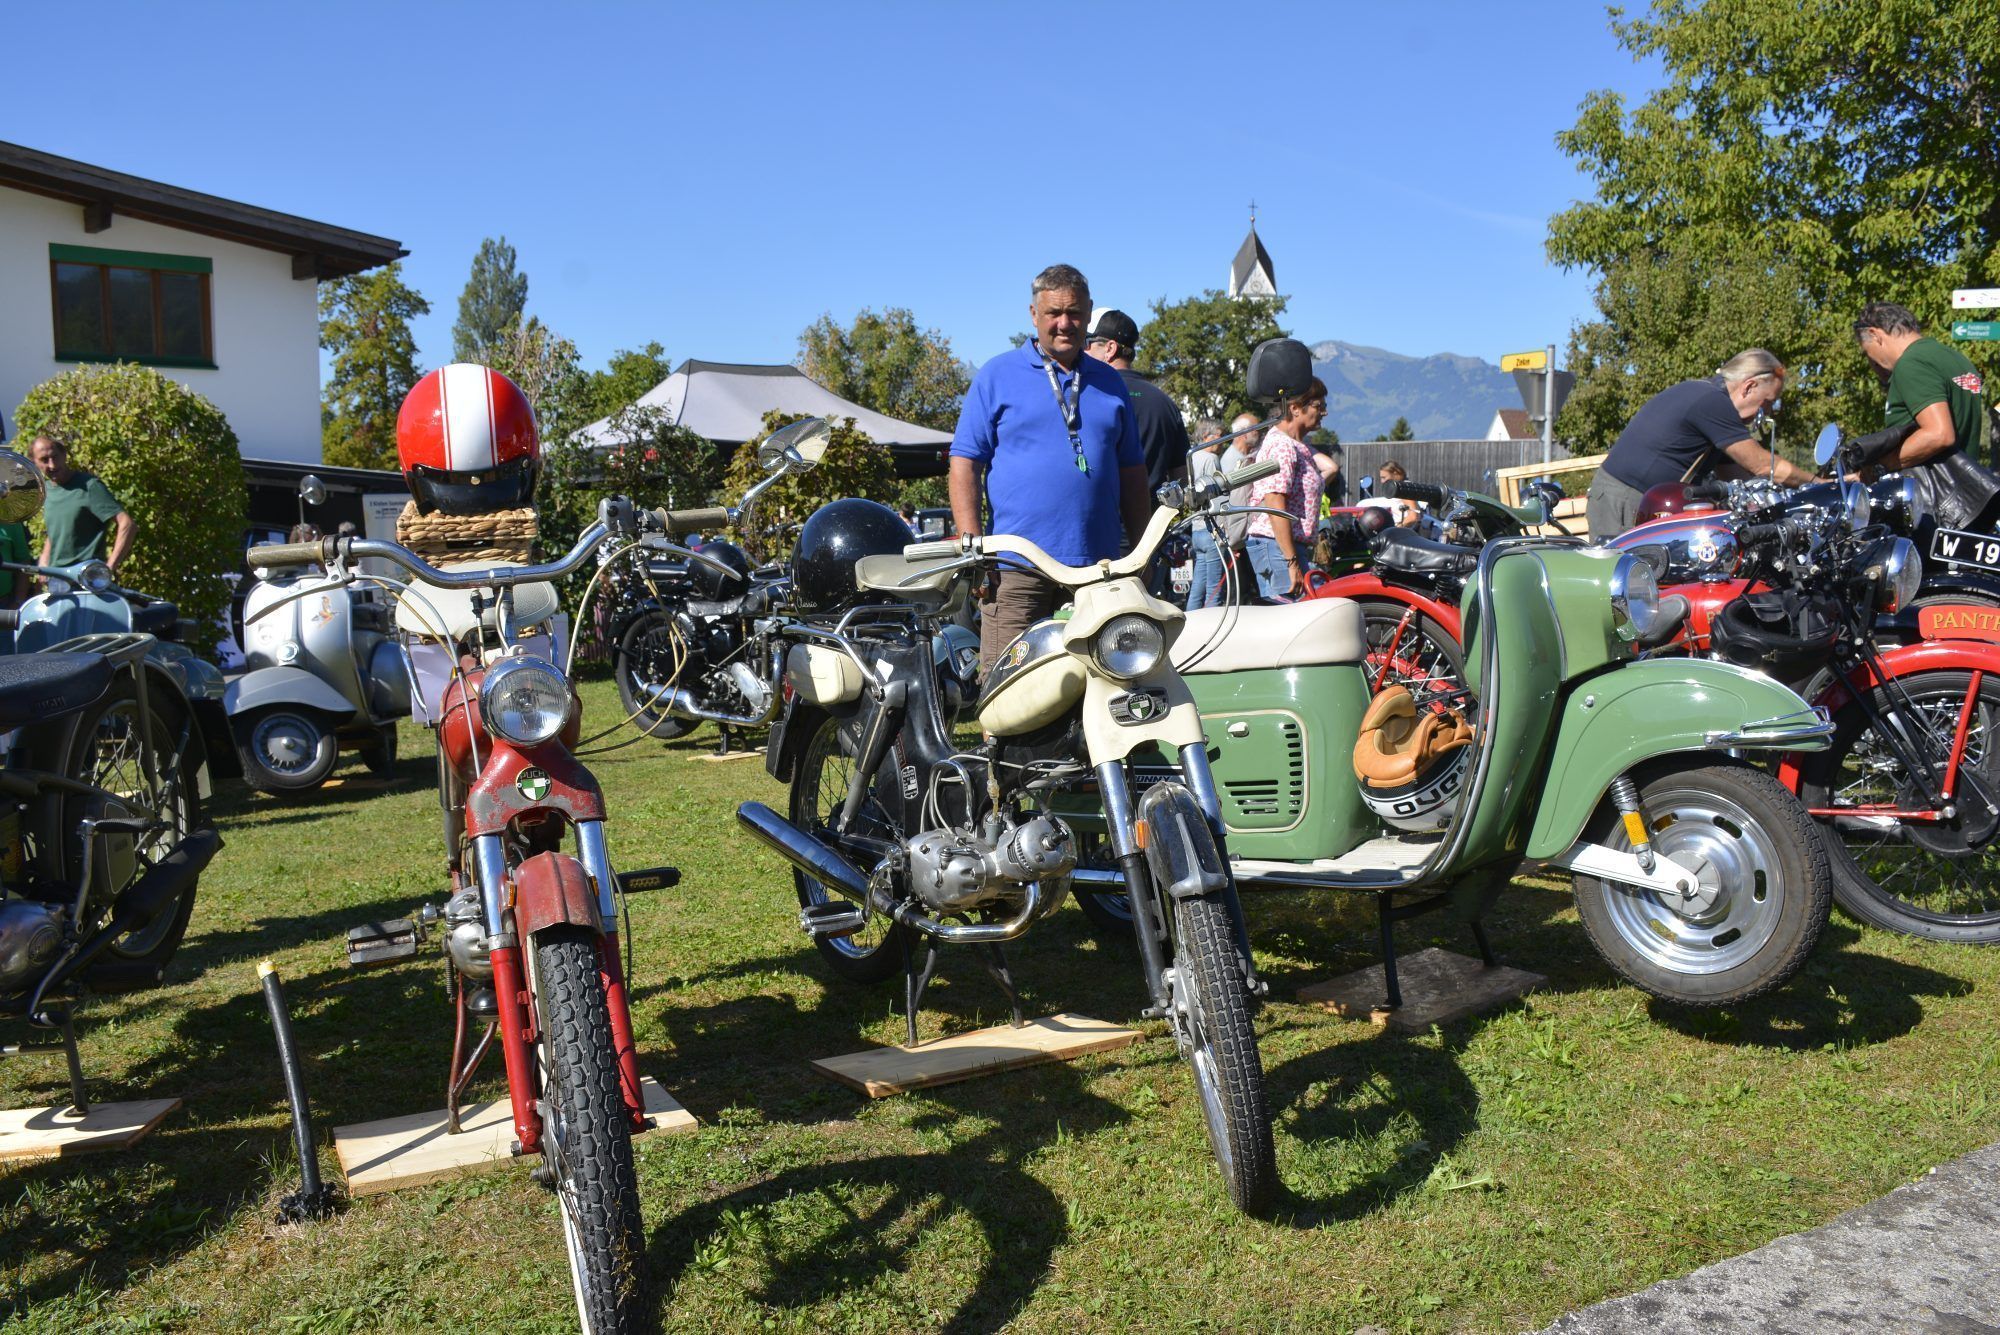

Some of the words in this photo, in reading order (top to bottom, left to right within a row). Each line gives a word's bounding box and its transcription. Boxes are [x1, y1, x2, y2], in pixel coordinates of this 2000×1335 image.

[1942, 534, 1960, 558] W
[1129, 694, 1149, 703] PUCH
[520, 770, 546, 780] PUCH
[1135, 775, 1170, 783] ONNY
